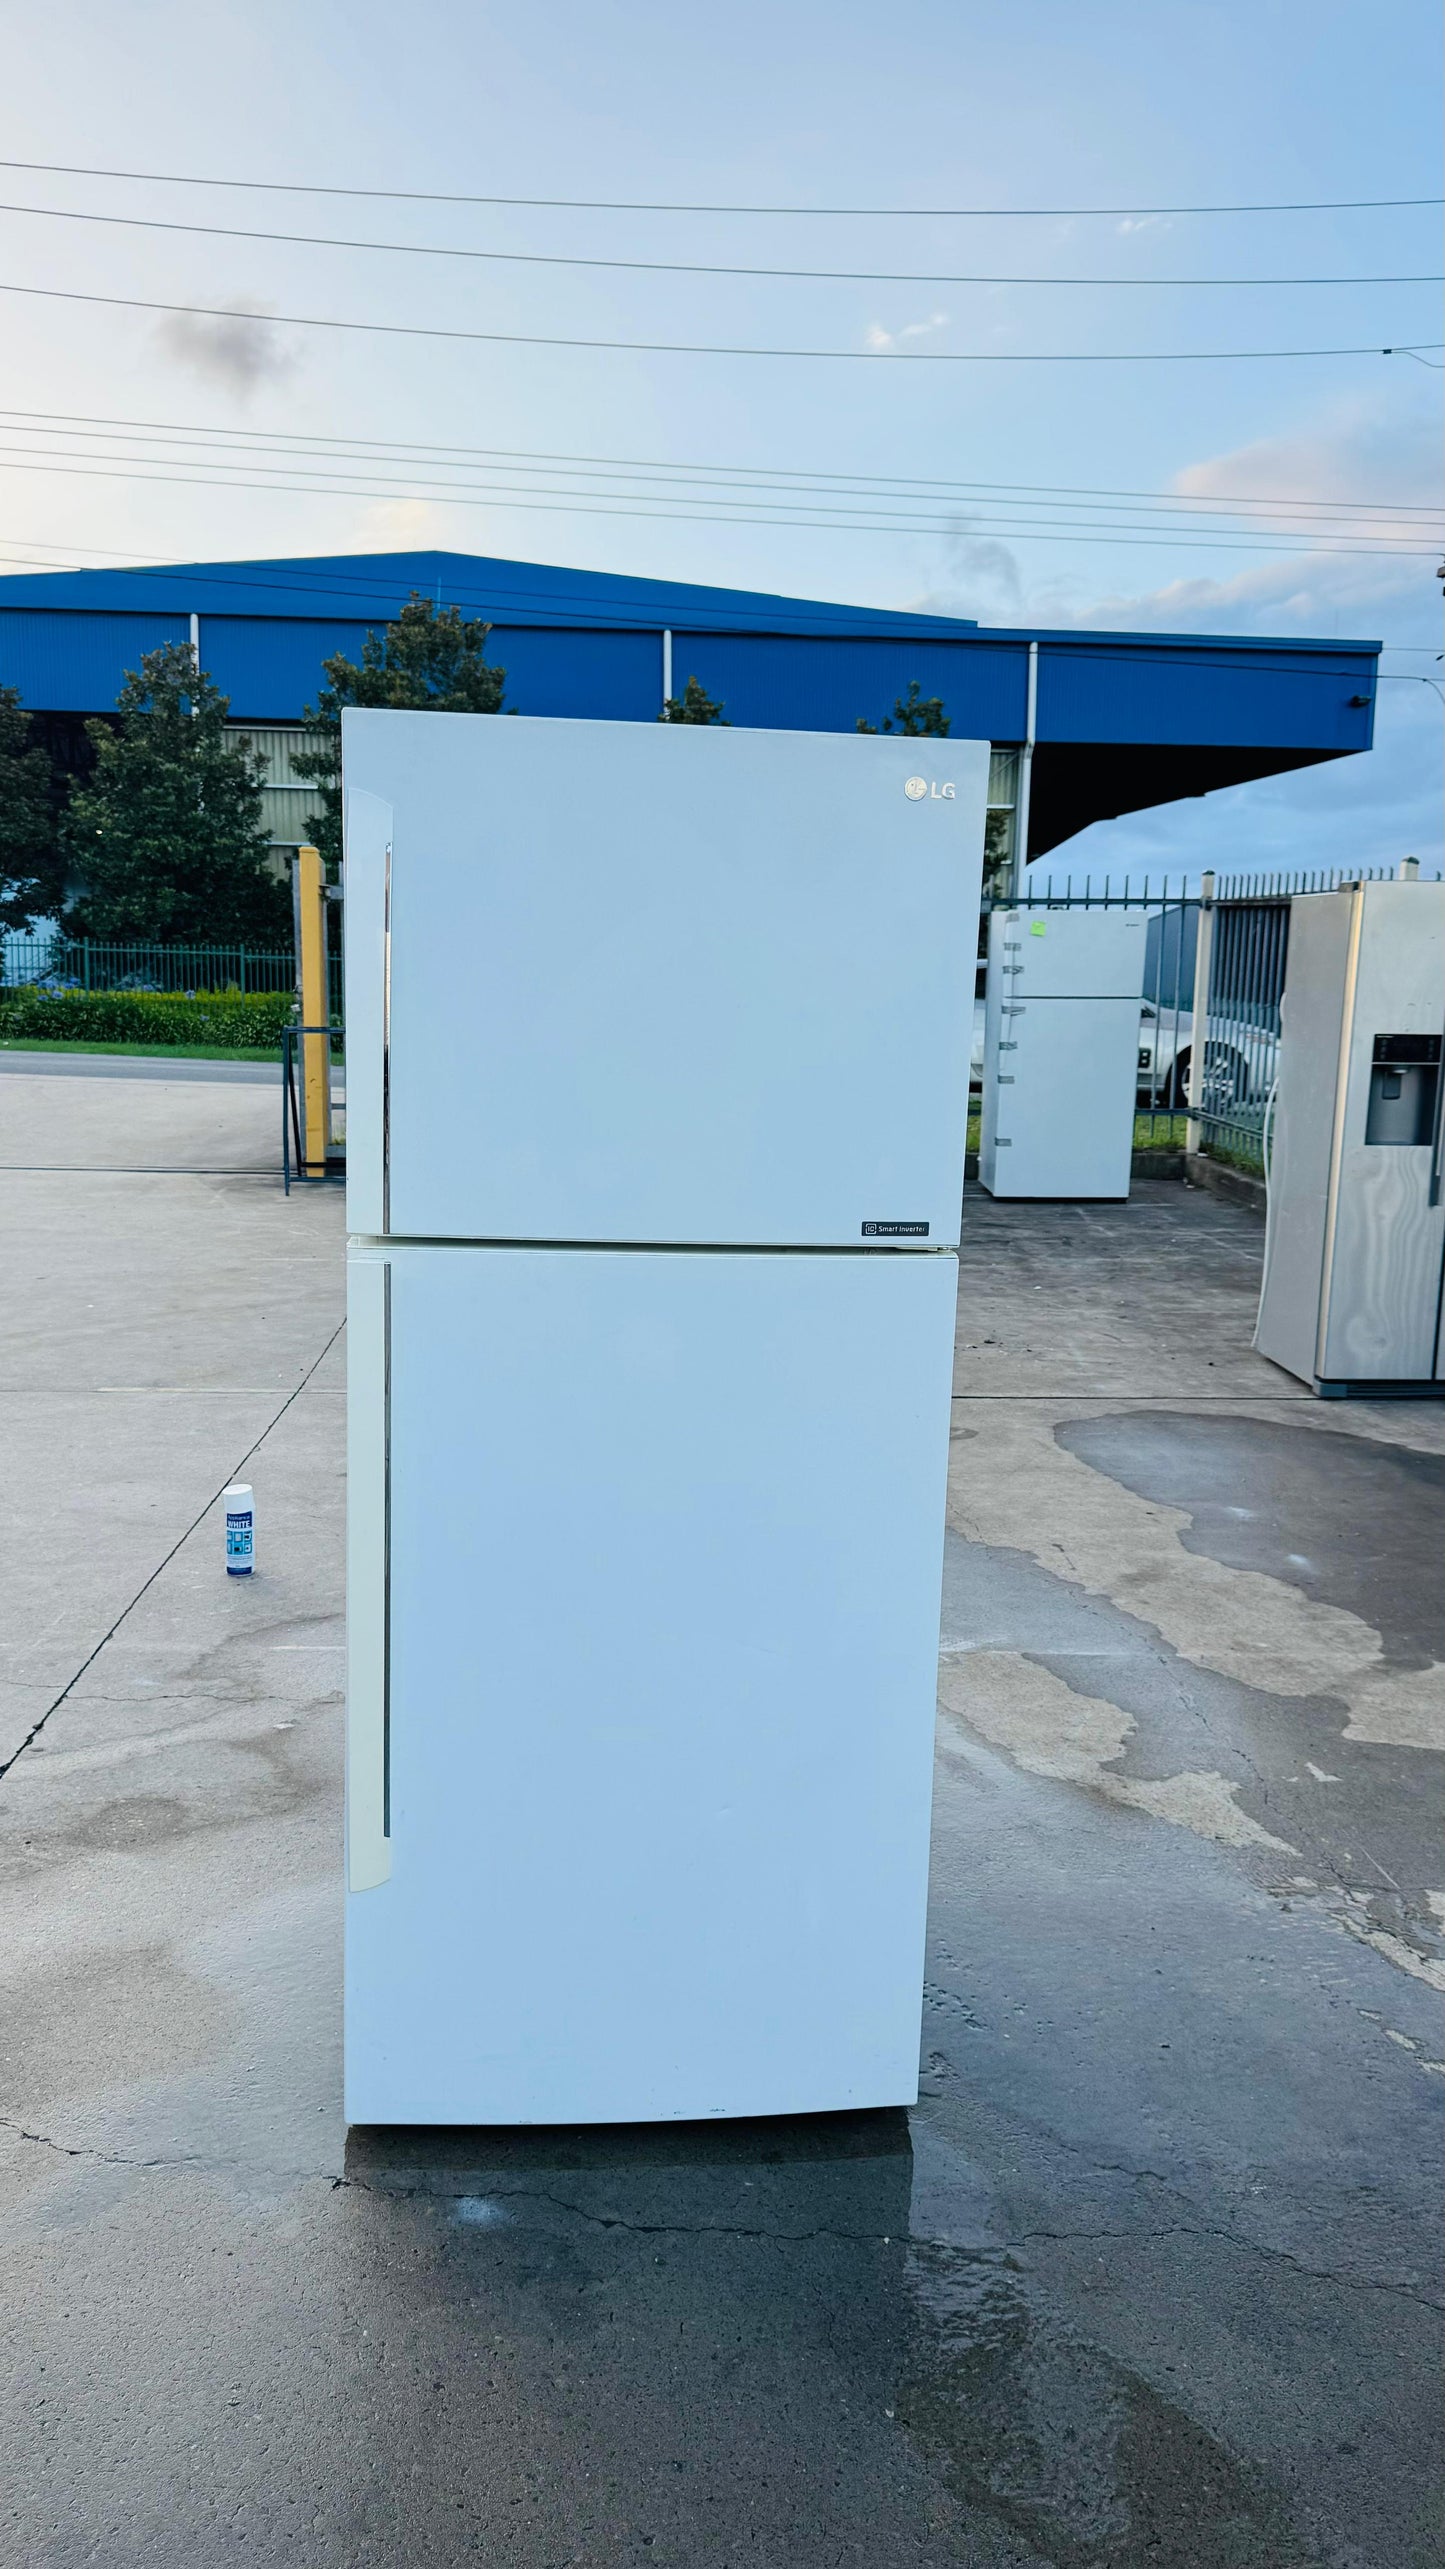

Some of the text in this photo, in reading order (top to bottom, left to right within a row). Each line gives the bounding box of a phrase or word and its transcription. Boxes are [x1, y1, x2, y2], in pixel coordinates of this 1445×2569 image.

[930, 781, 956, 799] LG
[878, 1225, 898, 1233] Smart
[898, 1225, 925, 1233] Inverter
[227, 1520, 251, 1529] WHITE
